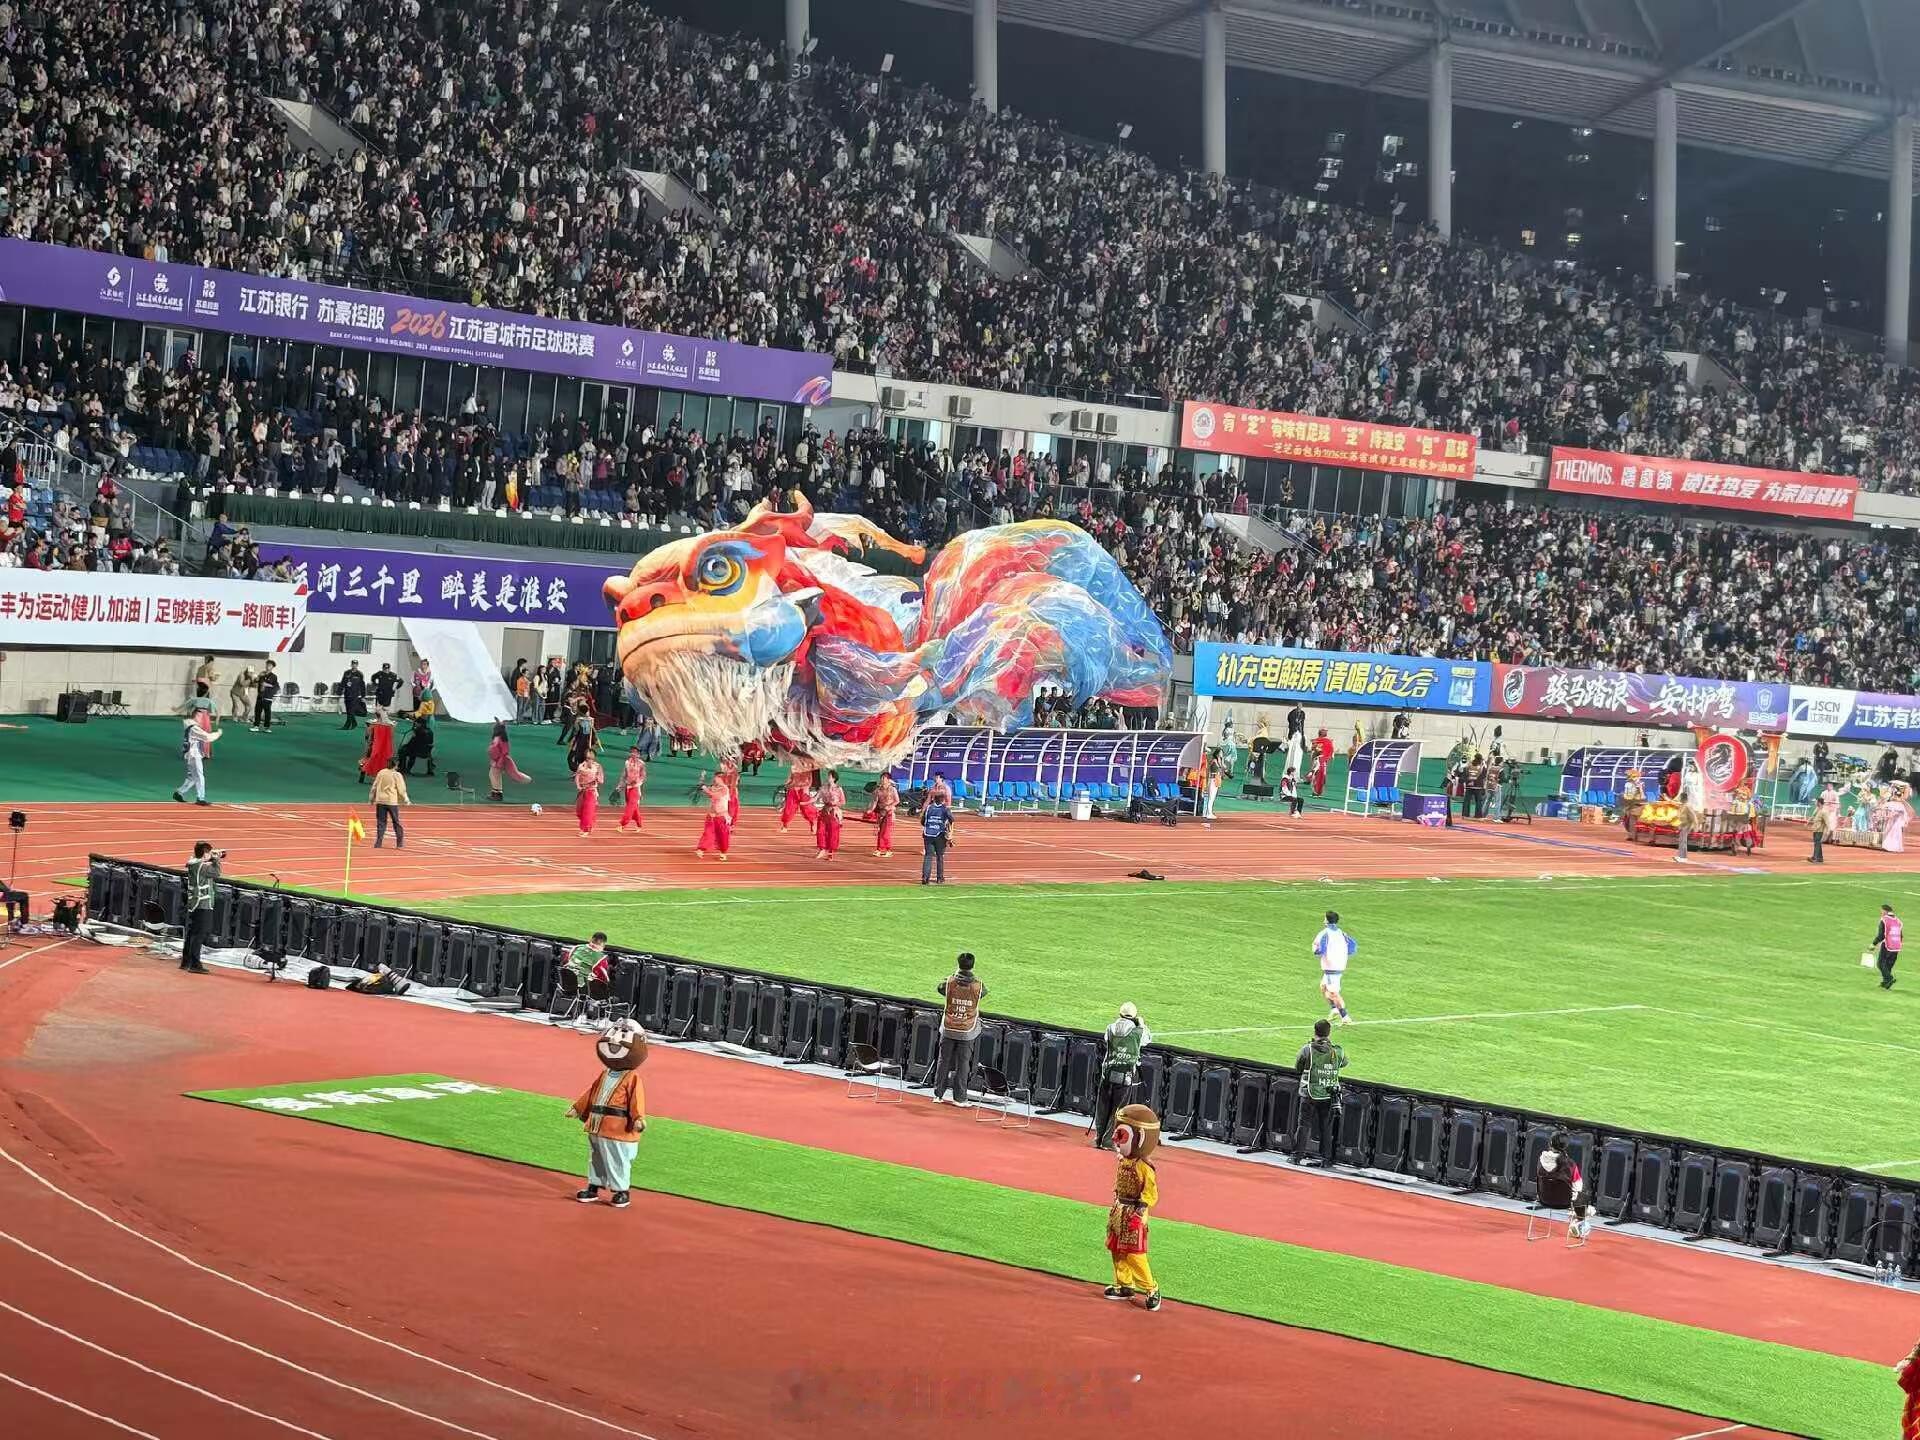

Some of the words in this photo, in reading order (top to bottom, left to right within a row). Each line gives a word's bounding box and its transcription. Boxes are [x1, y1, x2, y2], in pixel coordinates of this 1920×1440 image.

[239, 287, 310, 320] 江苏银行
[316, 298, 385, 331] 苏豪控股
[390, 307, 448, 340] 2026
[449, 315, 595, 358] 江苏省城市足球联赛
[442, 570, 569, 614] 醉美是淮安
[1216, 652, 1325, 693] 补充电解质
[1538, 672, 1640, 715] 骏马踏浪
[1811, 699, 1840, 713] JSCN
